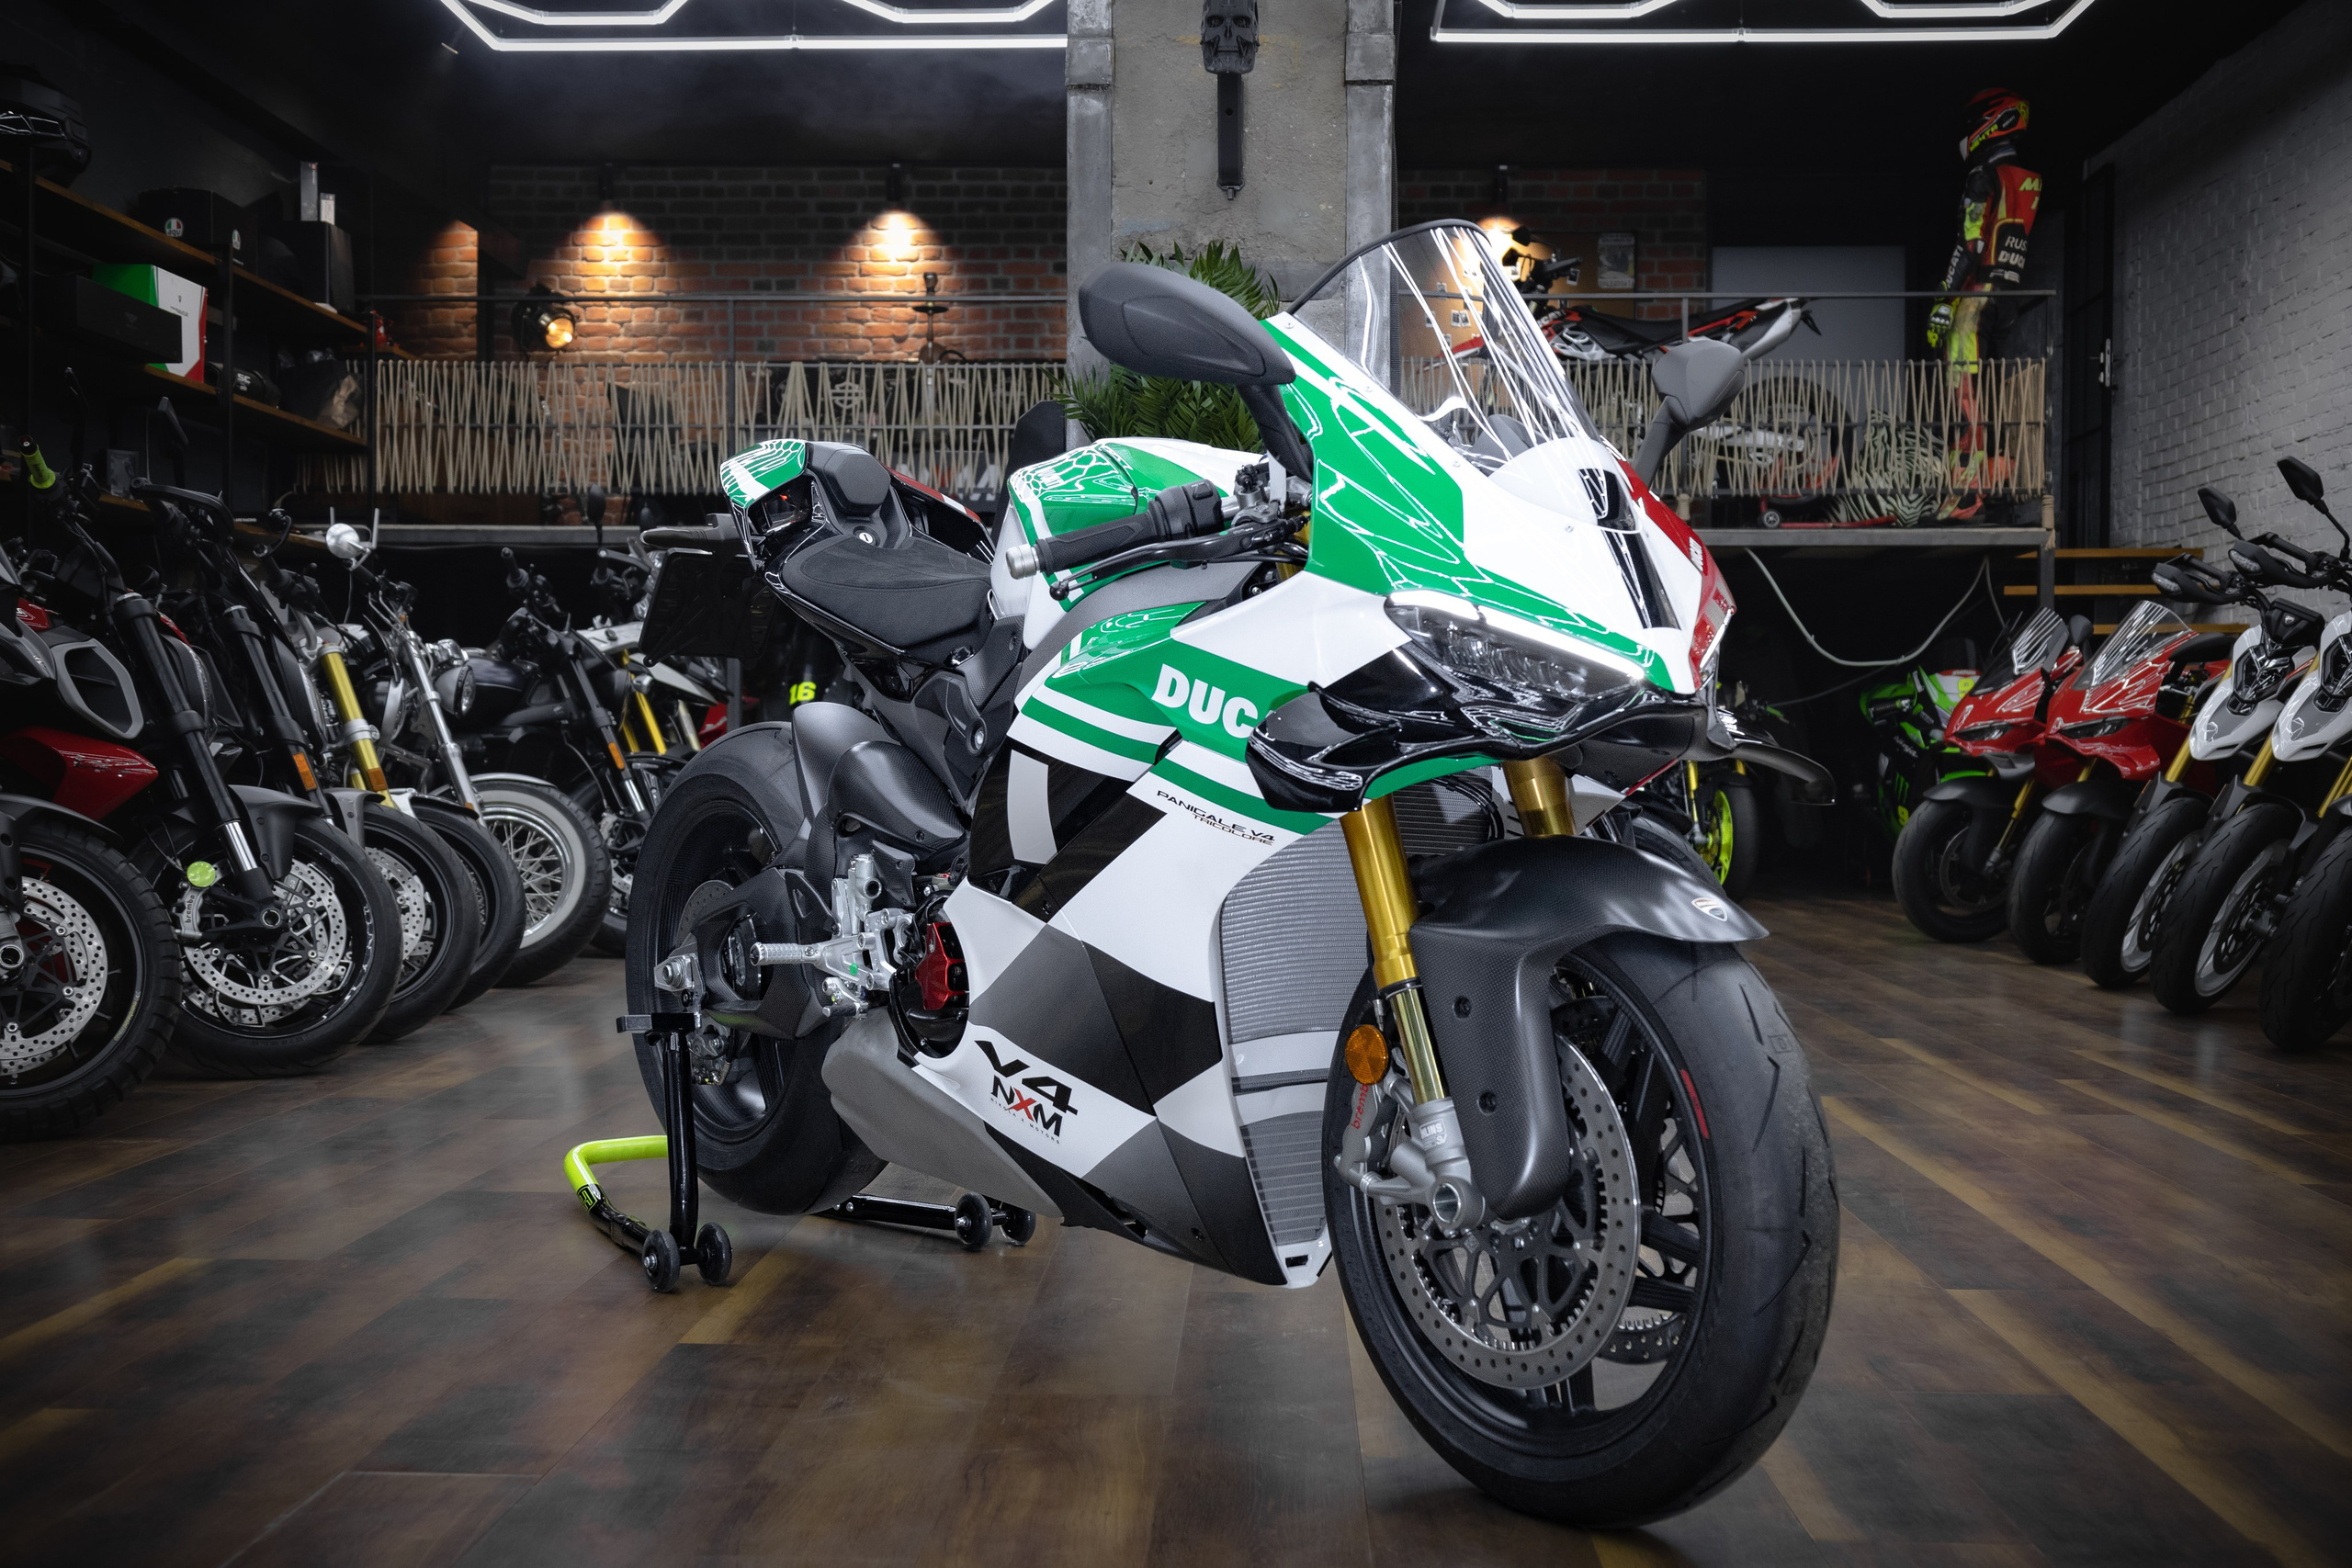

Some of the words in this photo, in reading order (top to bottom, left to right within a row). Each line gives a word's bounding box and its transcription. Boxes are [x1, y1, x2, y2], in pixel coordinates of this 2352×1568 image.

[2005, 235, 2029, 252] RUS
[1946, 246, 1963, 290] UCATI
[788, 681, 817, 706] 16
[1150, 662, 1277, 739] DUC
[1157, 790, 1247, 833] PANIGALE
[1250, 829, 1275, 841] V4
[1193, 813, 1273, 846] TRICOLORE
[185, 895, 195, 924] brembo
[975, 1041, 1079, 1115] V4
[990, 1075, 1063, 1138] NXM
[1351, 1083, 1369, 1130] bremb
[1029, 1122, 1060, 1145] MOTORS
